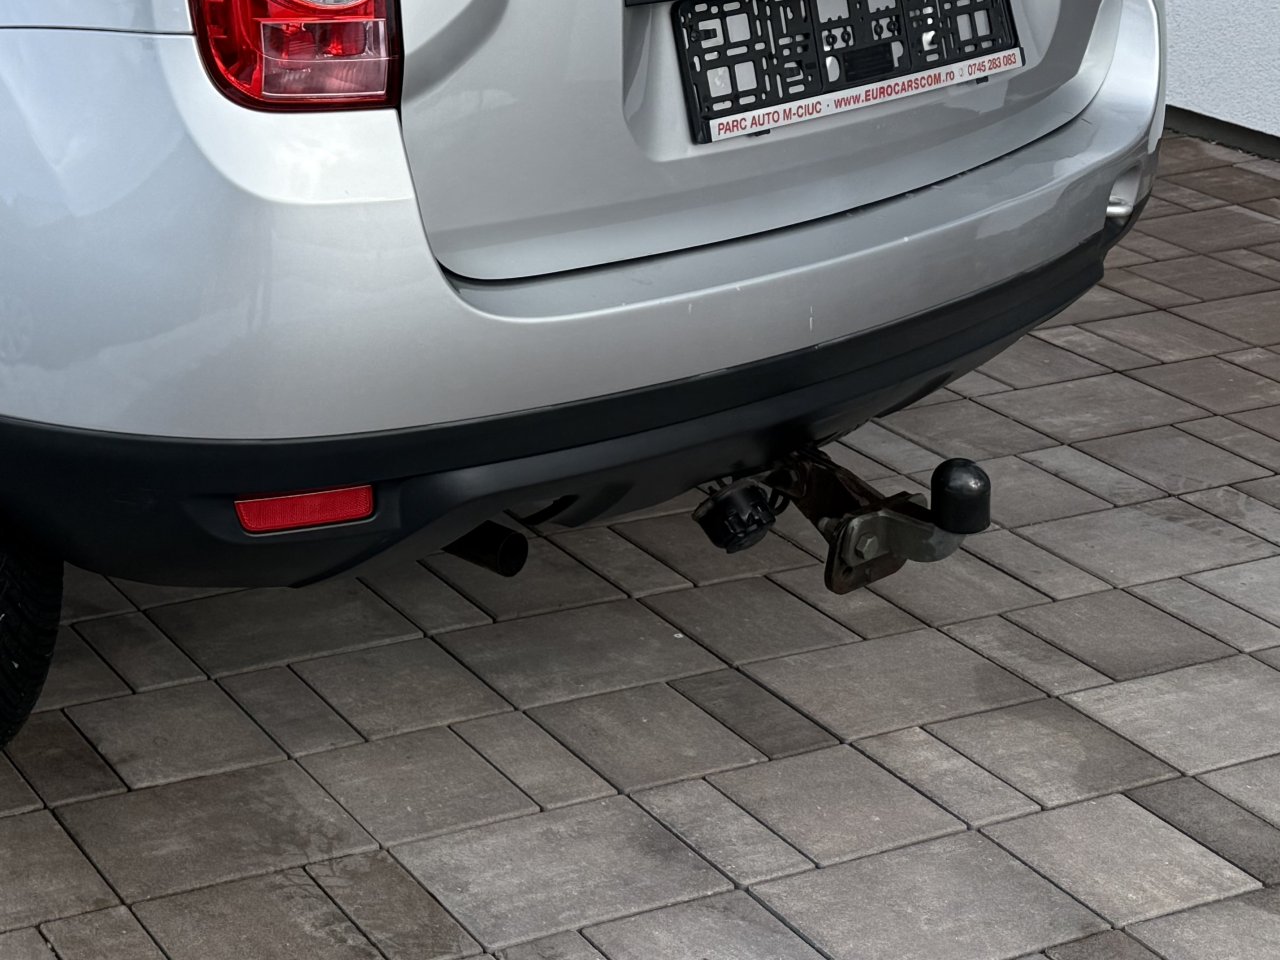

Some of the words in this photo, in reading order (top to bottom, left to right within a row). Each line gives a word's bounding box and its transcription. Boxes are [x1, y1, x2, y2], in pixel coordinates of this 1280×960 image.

[717, 118, 747, 136] PARC
[750, 110, 780, 128] AUTO
[783, 101, 822, 121] M-CIUC
[967, 60, 986, 76] 0745
[987, 56, 1002, 71] 283
[1002, 52, 1017, 67] 083
